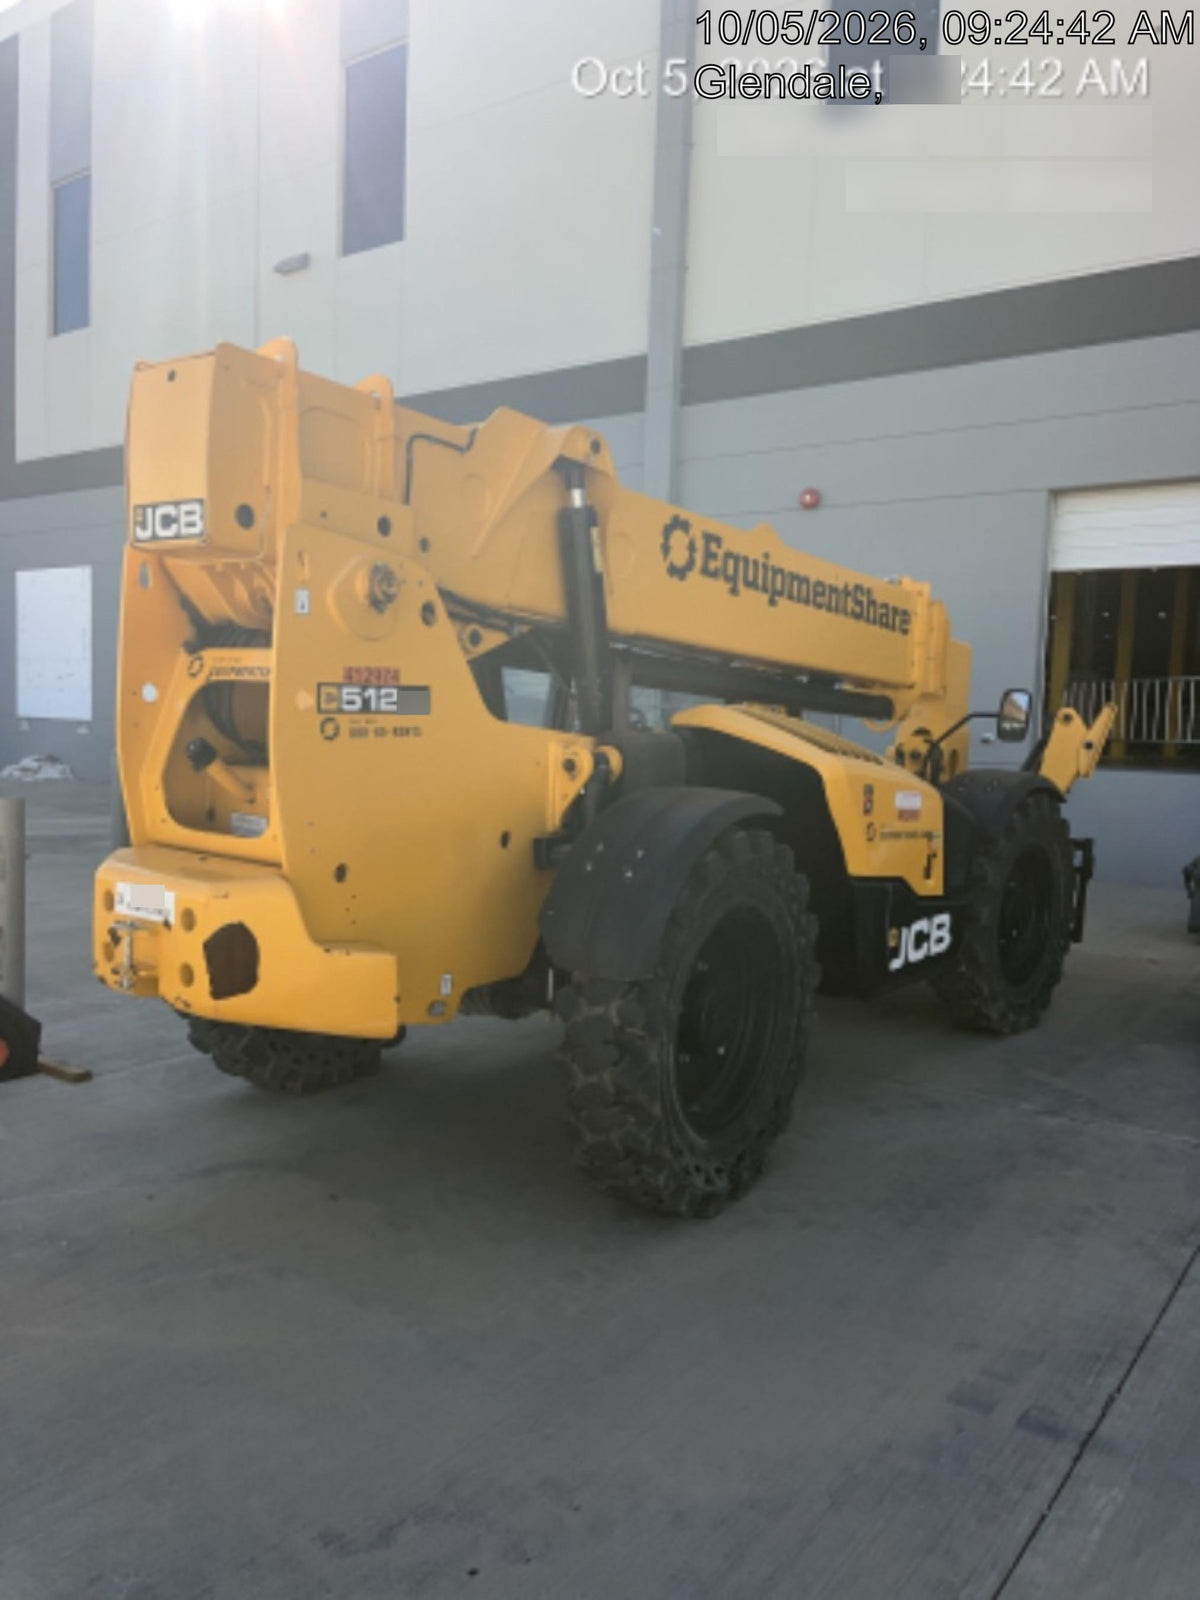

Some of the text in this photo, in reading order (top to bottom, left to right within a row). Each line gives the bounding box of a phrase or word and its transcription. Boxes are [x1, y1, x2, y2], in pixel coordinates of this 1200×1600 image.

[135, 502, 203, 540] JCB
[701, 531, 911, 635] EquipmentShare
[889, 913, 952, 971] JCB
